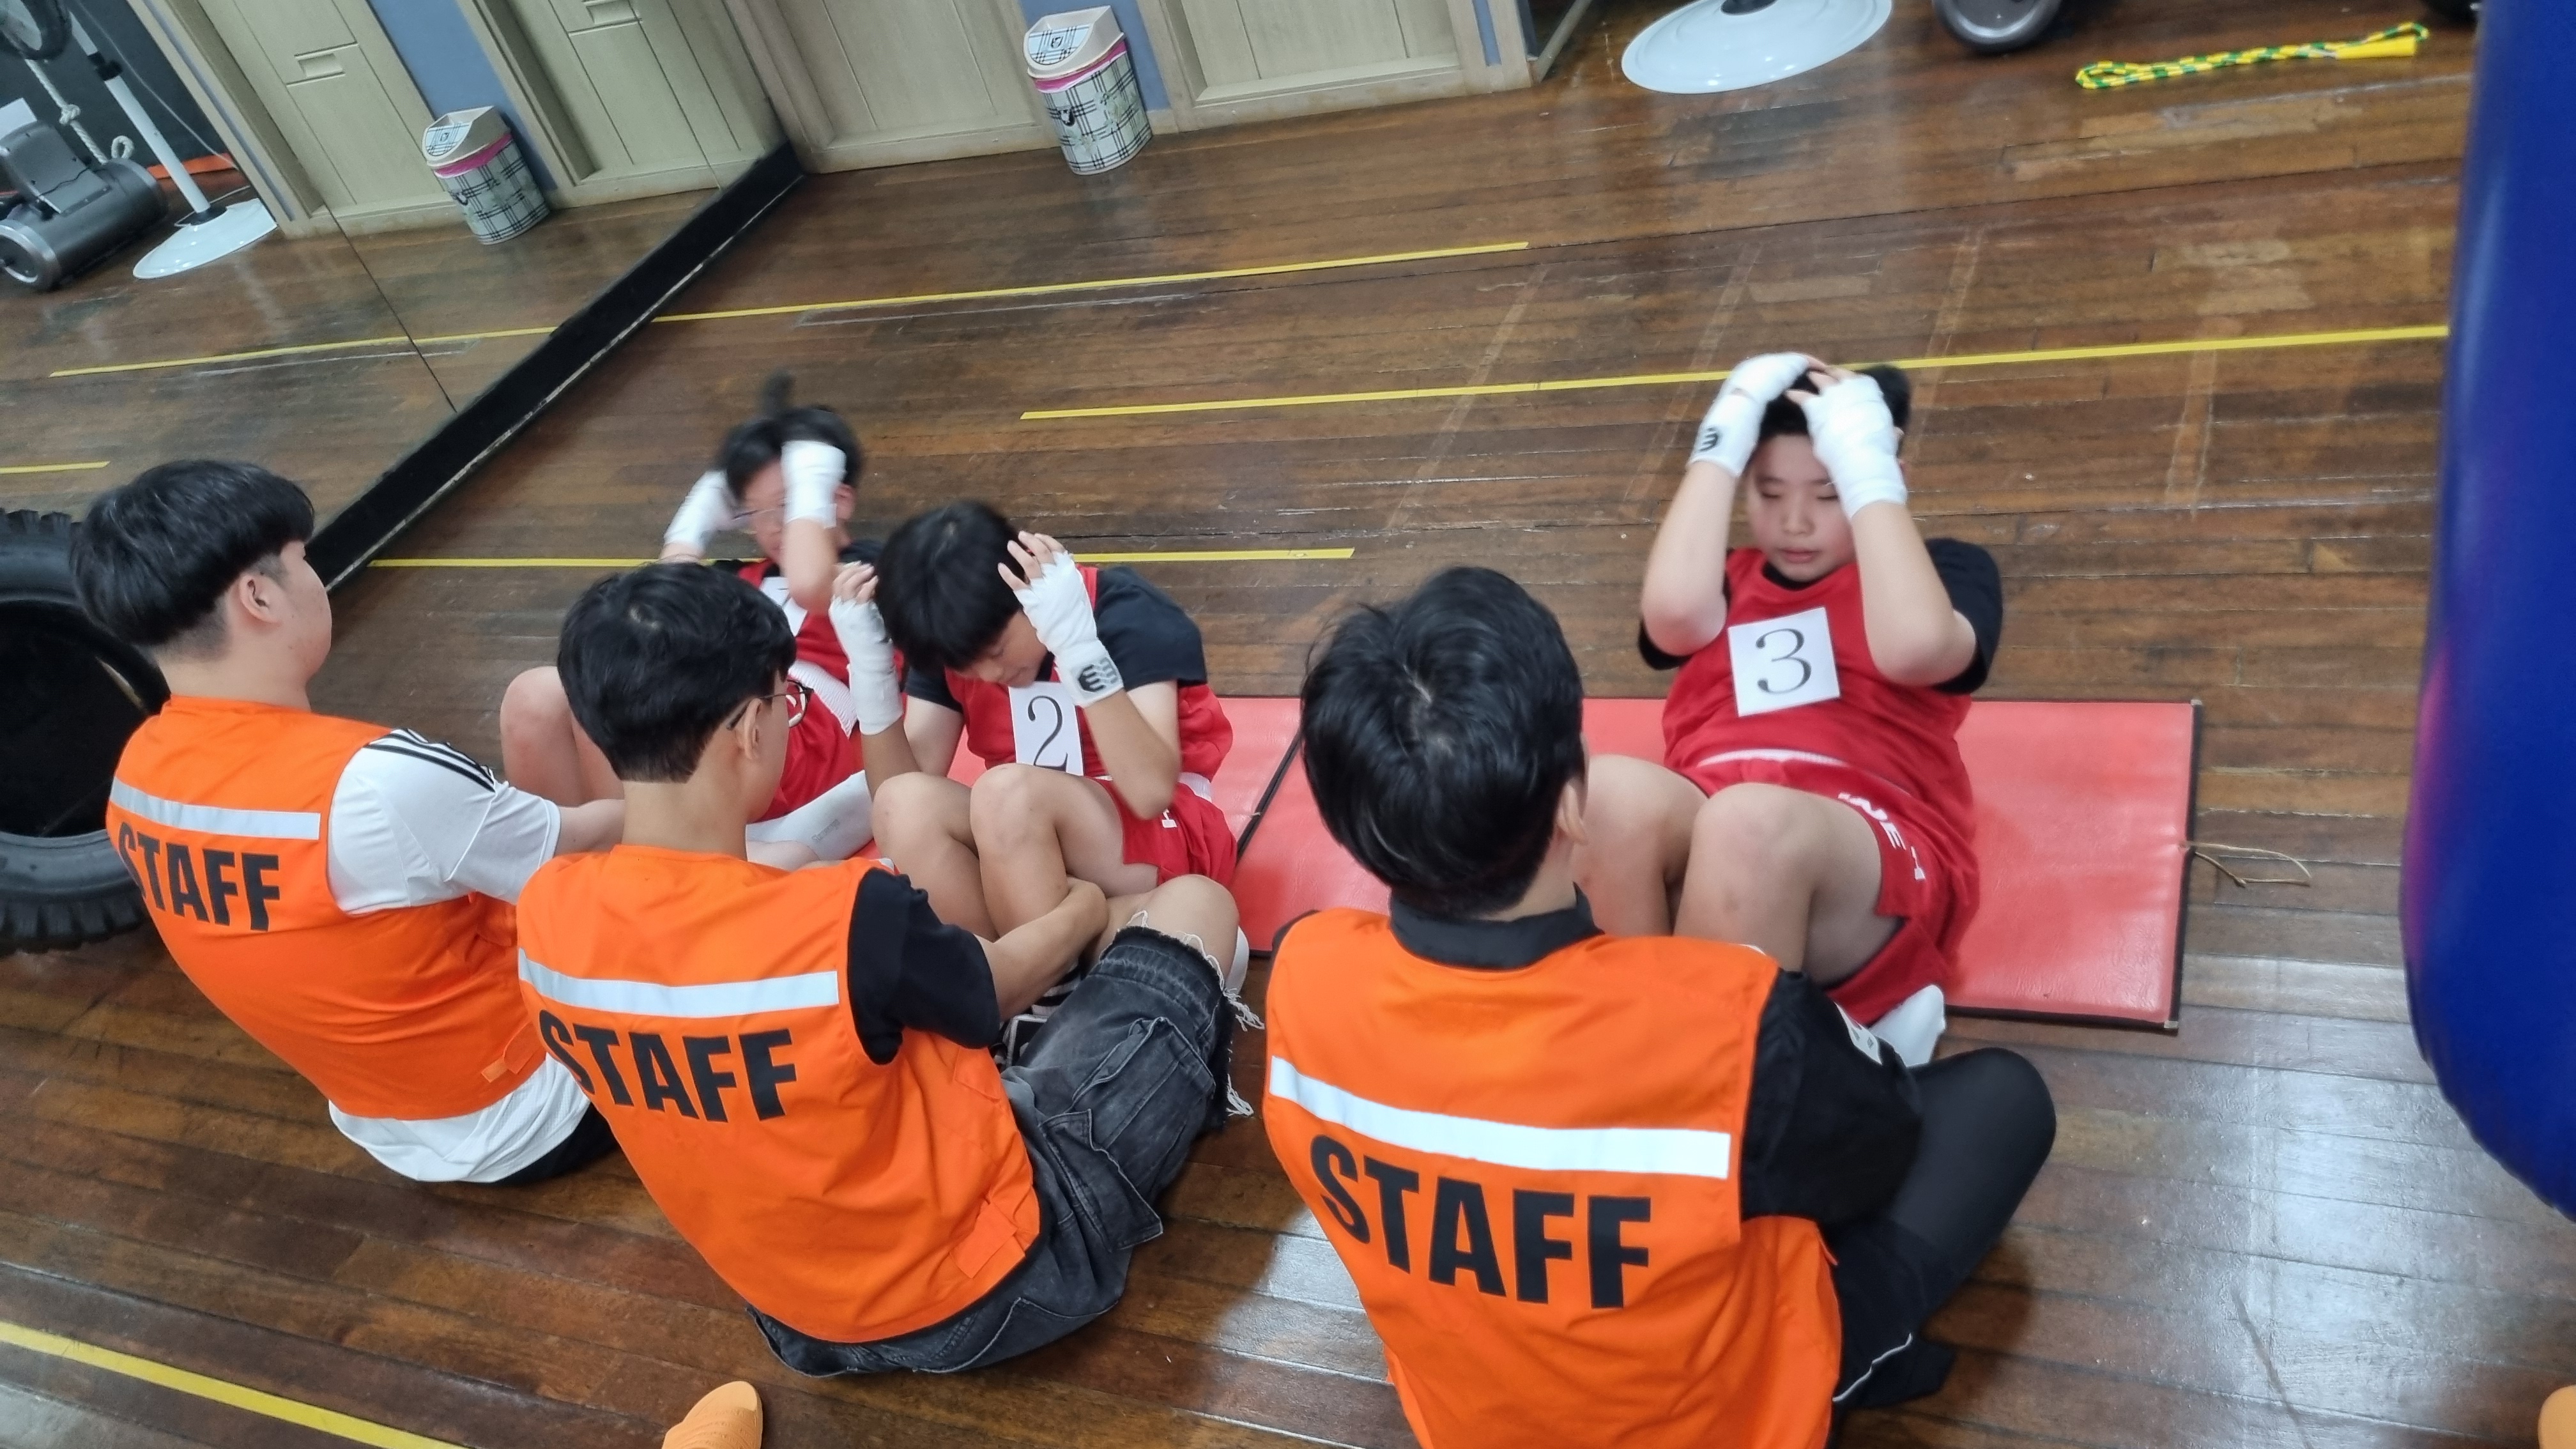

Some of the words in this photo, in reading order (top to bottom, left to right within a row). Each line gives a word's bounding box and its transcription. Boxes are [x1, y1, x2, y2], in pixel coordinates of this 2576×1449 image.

[1755, 628, 1812, 694] 3
[1027, 695, 1068, 772] 2
[118, 822, 280, 931] STAFF
[539, 1009, 797, 1123] STAFF
[1310, 1134, 1652, 1309] STAFF
